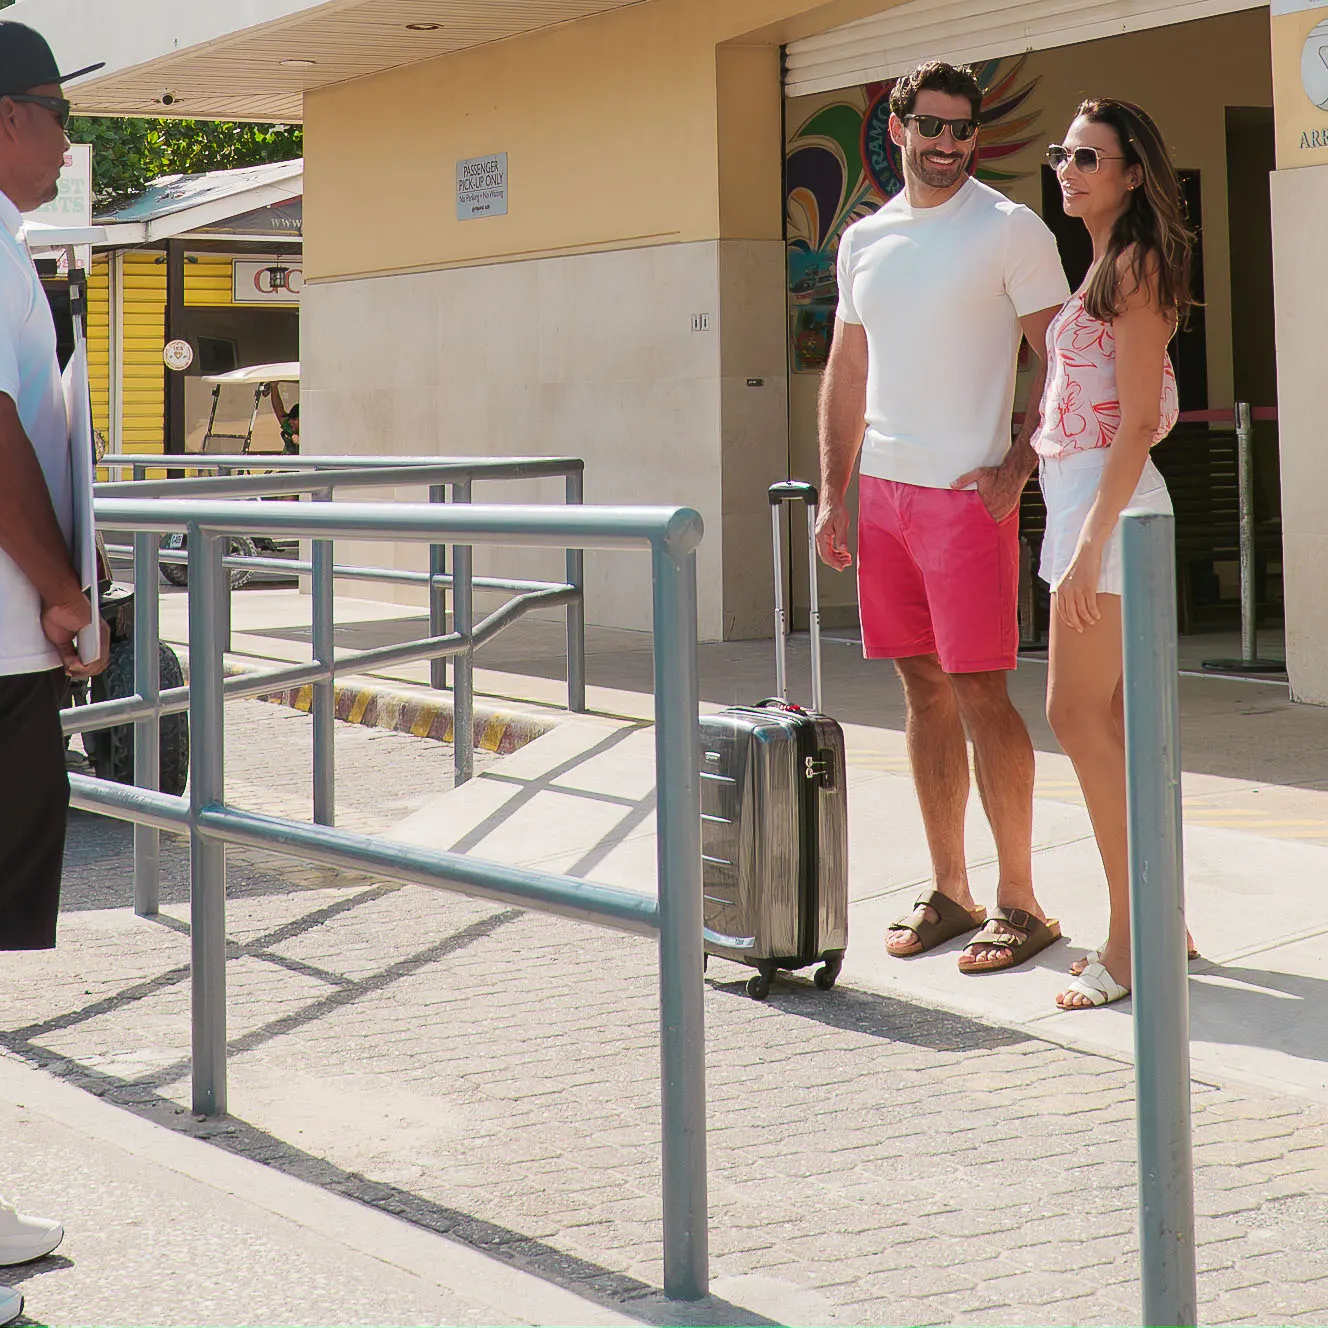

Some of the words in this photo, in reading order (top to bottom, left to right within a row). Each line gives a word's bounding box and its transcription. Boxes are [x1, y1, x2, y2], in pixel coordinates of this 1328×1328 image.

[463, 160, 499, 178] PASSENGER
[458, 176, 484, 191] PICK-UP
[485, 172, 504, 187] ONLY
